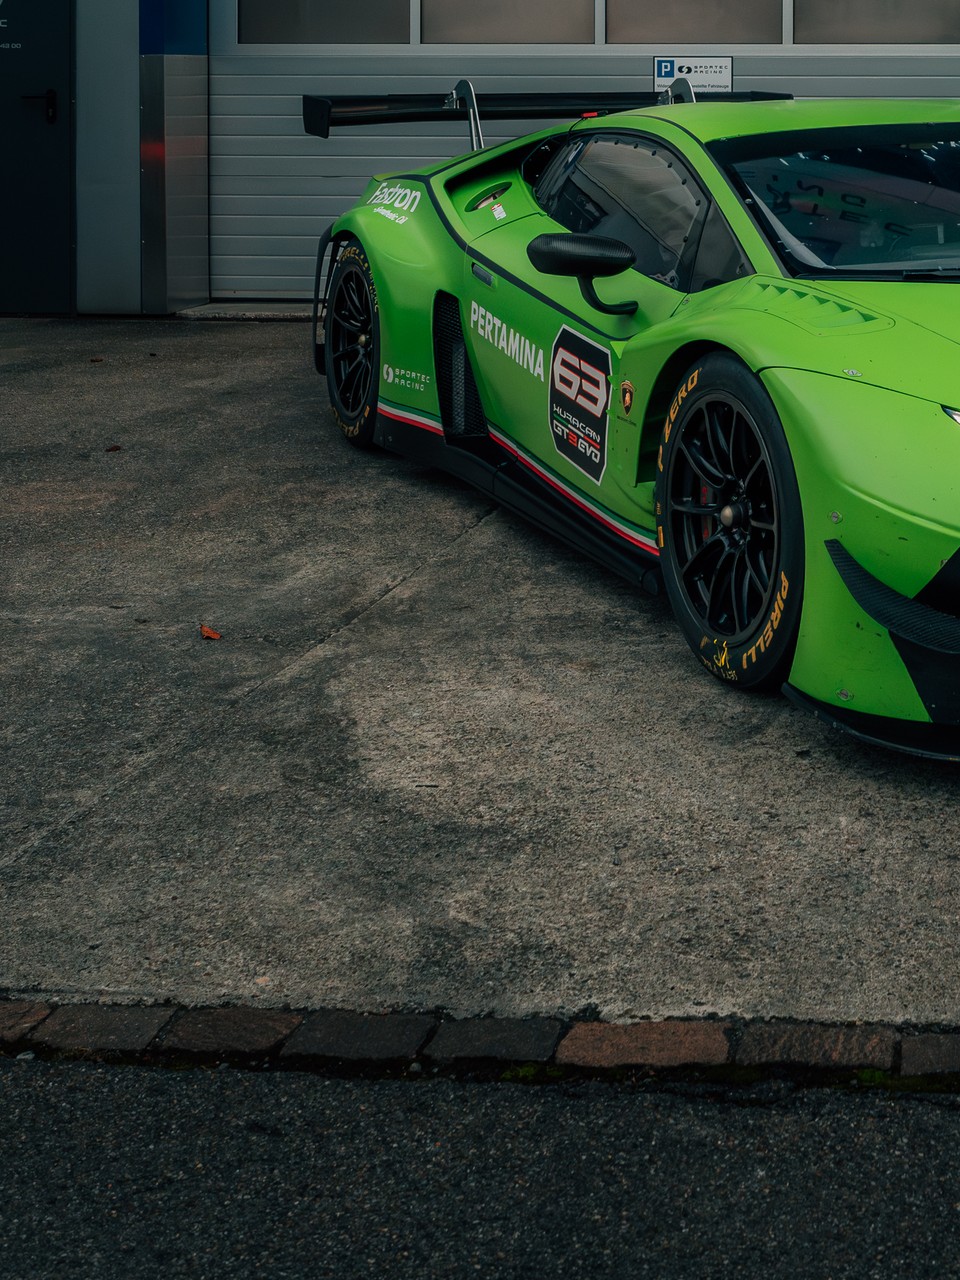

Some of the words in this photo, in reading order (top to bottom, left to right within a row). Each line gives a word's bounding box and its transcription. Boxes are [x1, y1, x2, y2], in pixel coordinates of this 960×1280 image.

[661, 62, 671, 76] P
[366, 182, 421, 213] Fastron
[470, 300, 545, 383] PERTAMINA
[394, 367, 431, 383] SPORTEC
[394, 377, 425, 391] RACING
[553, 346, 608, 419] 63
[553, 403, 601, 444] HURACAN
[742, 571, 789, 670] PIRELLI
